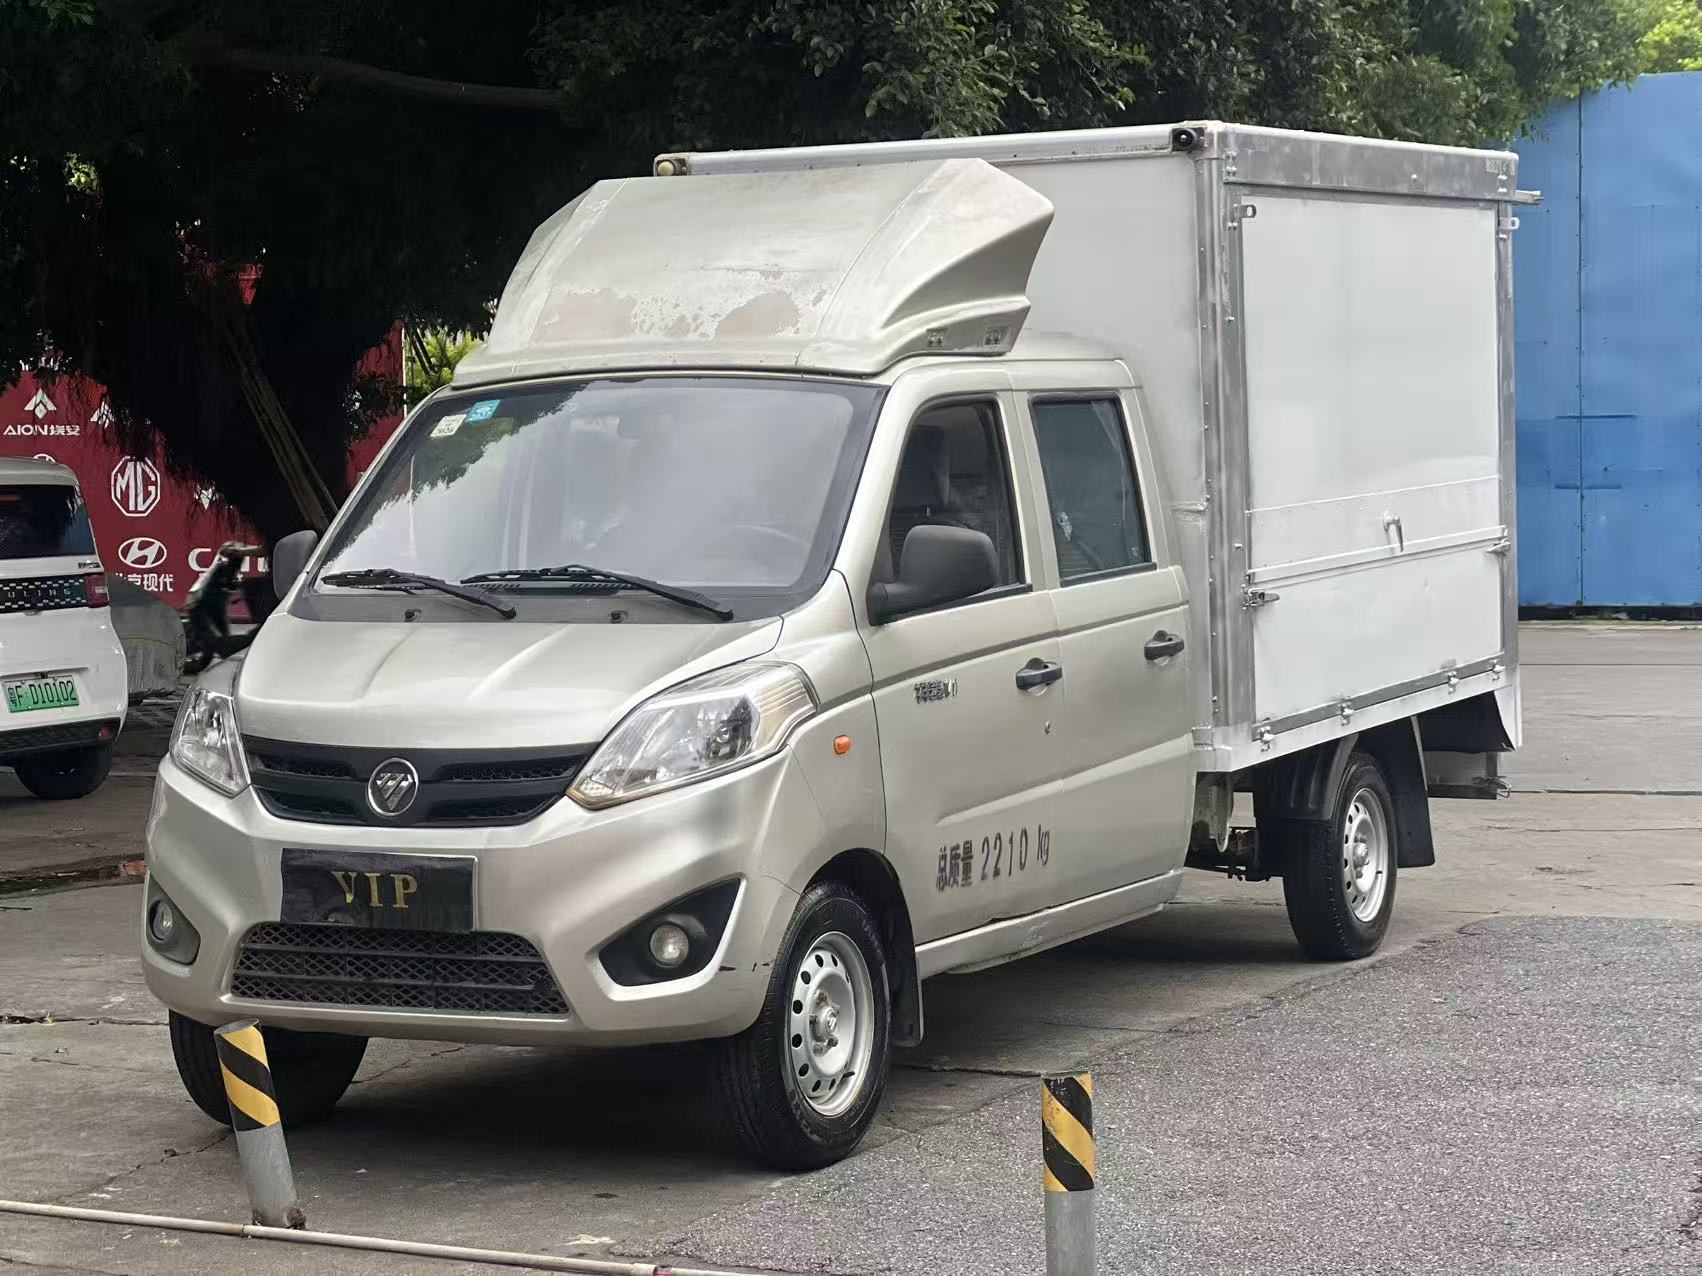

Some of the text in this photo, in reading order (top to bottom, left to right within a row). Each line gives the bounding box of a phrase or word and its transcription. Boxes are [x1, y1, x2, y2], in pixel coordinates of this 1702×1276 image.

[115, 460, 157, 512] MG
[936, 824, 1051, 893] 总质量 2210 kg
[331, 871, 418, 908] VIP
